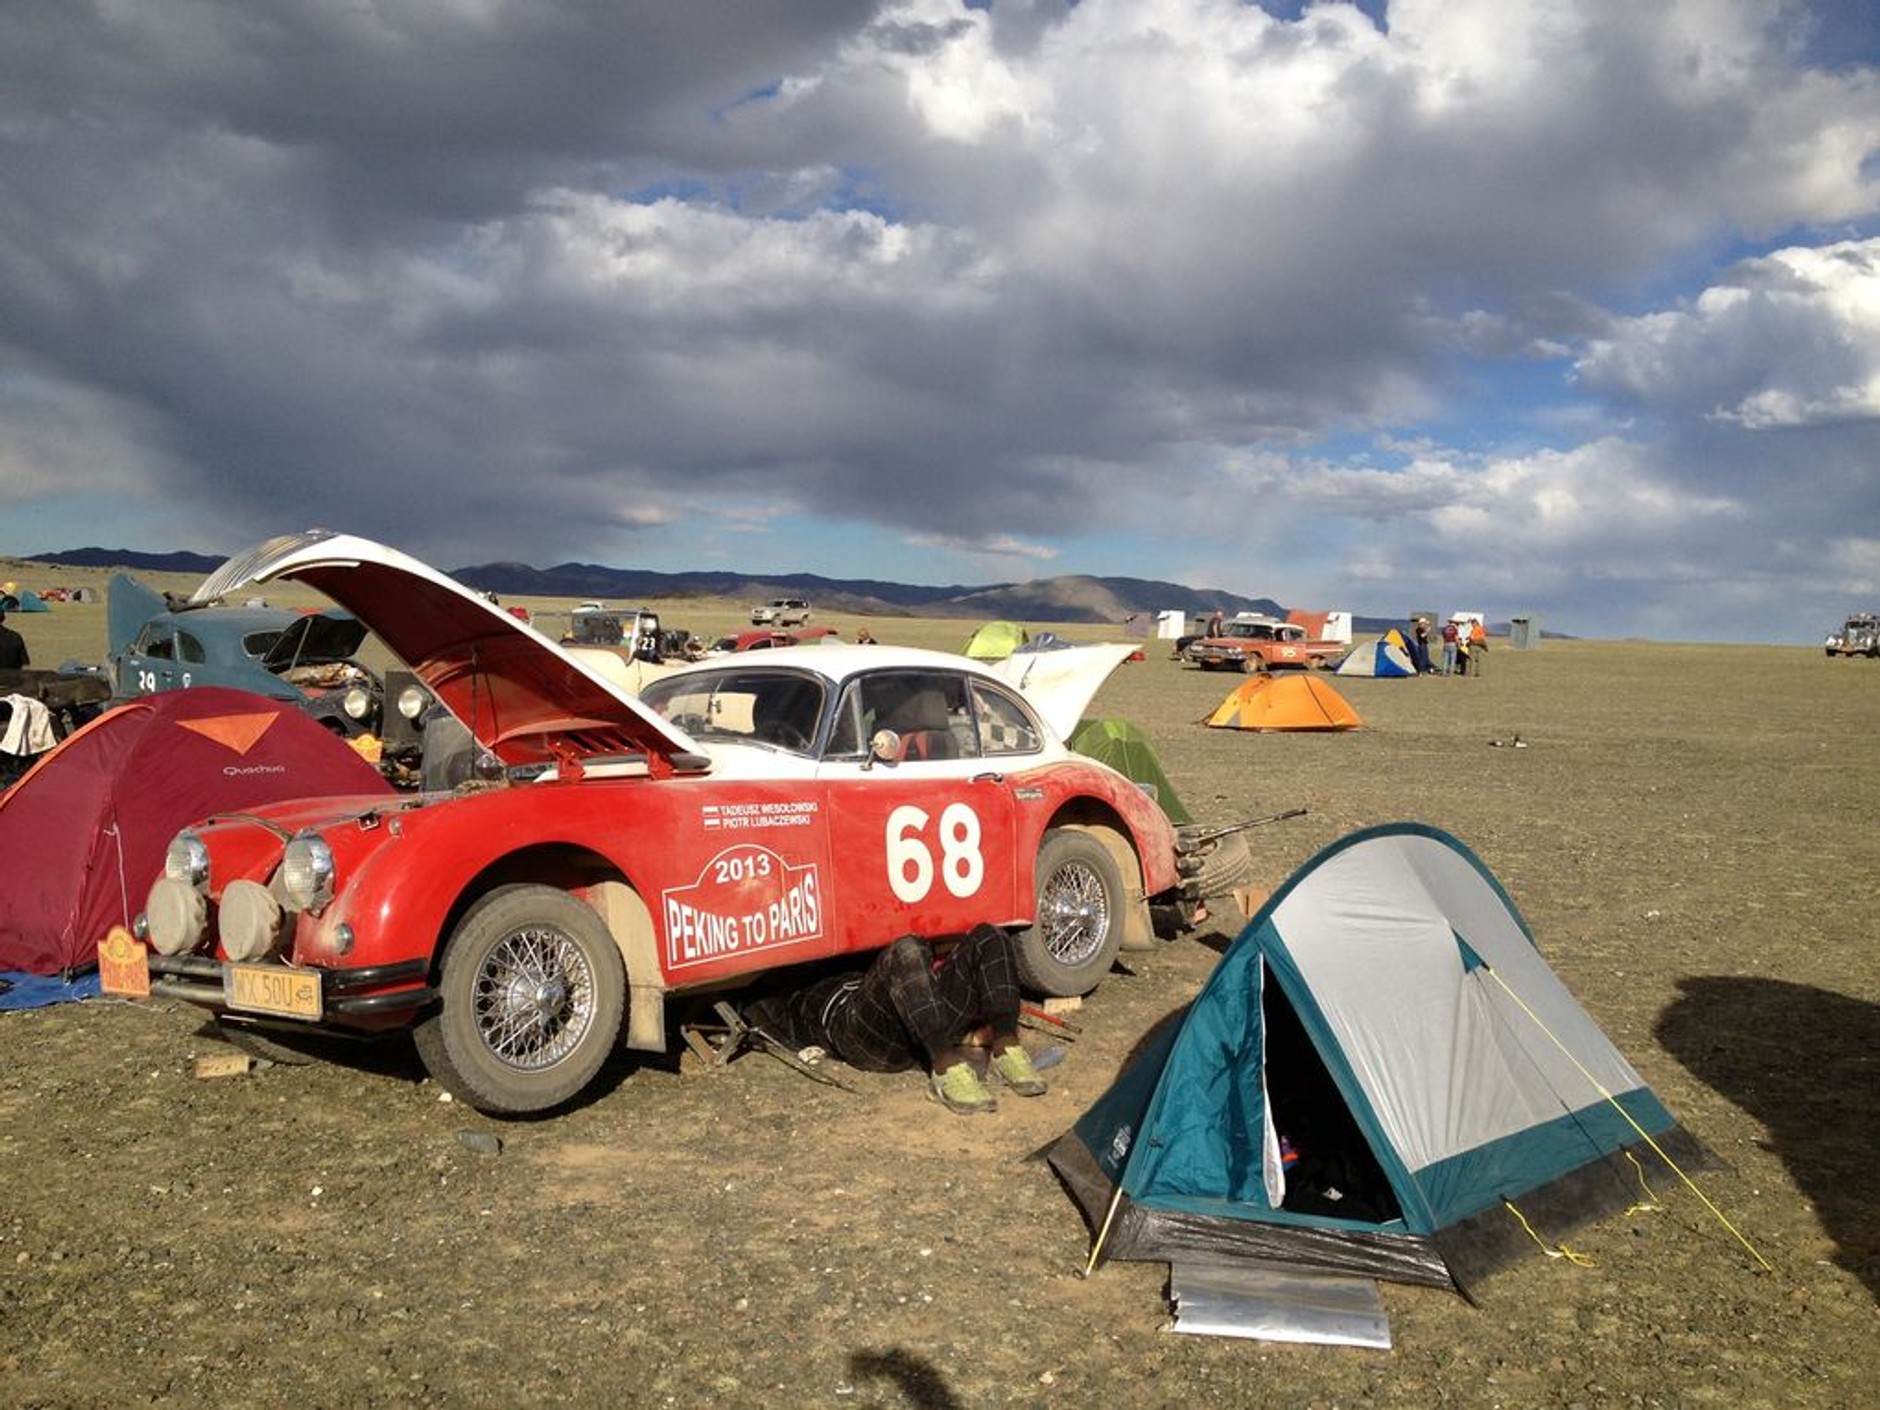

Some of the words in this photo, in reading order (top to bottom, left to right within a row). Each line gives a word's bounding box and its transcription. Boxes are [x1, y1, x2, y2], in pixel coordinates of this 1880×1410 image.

[641, 637, 656, 651] 23
[720, 803, 761, 816] TADEUSZ
[722, 817, 750, 829] PIOTR
[751, 815, 811, 827] LUBACZEWSKI
[885, 802, 984, 903] 68
[715, 853, 770, 884] 2013
[668, 898, 738, 961] PEKING
[742, 912, 766, 946] TO
[769, 872, 817, 941] PARIS
